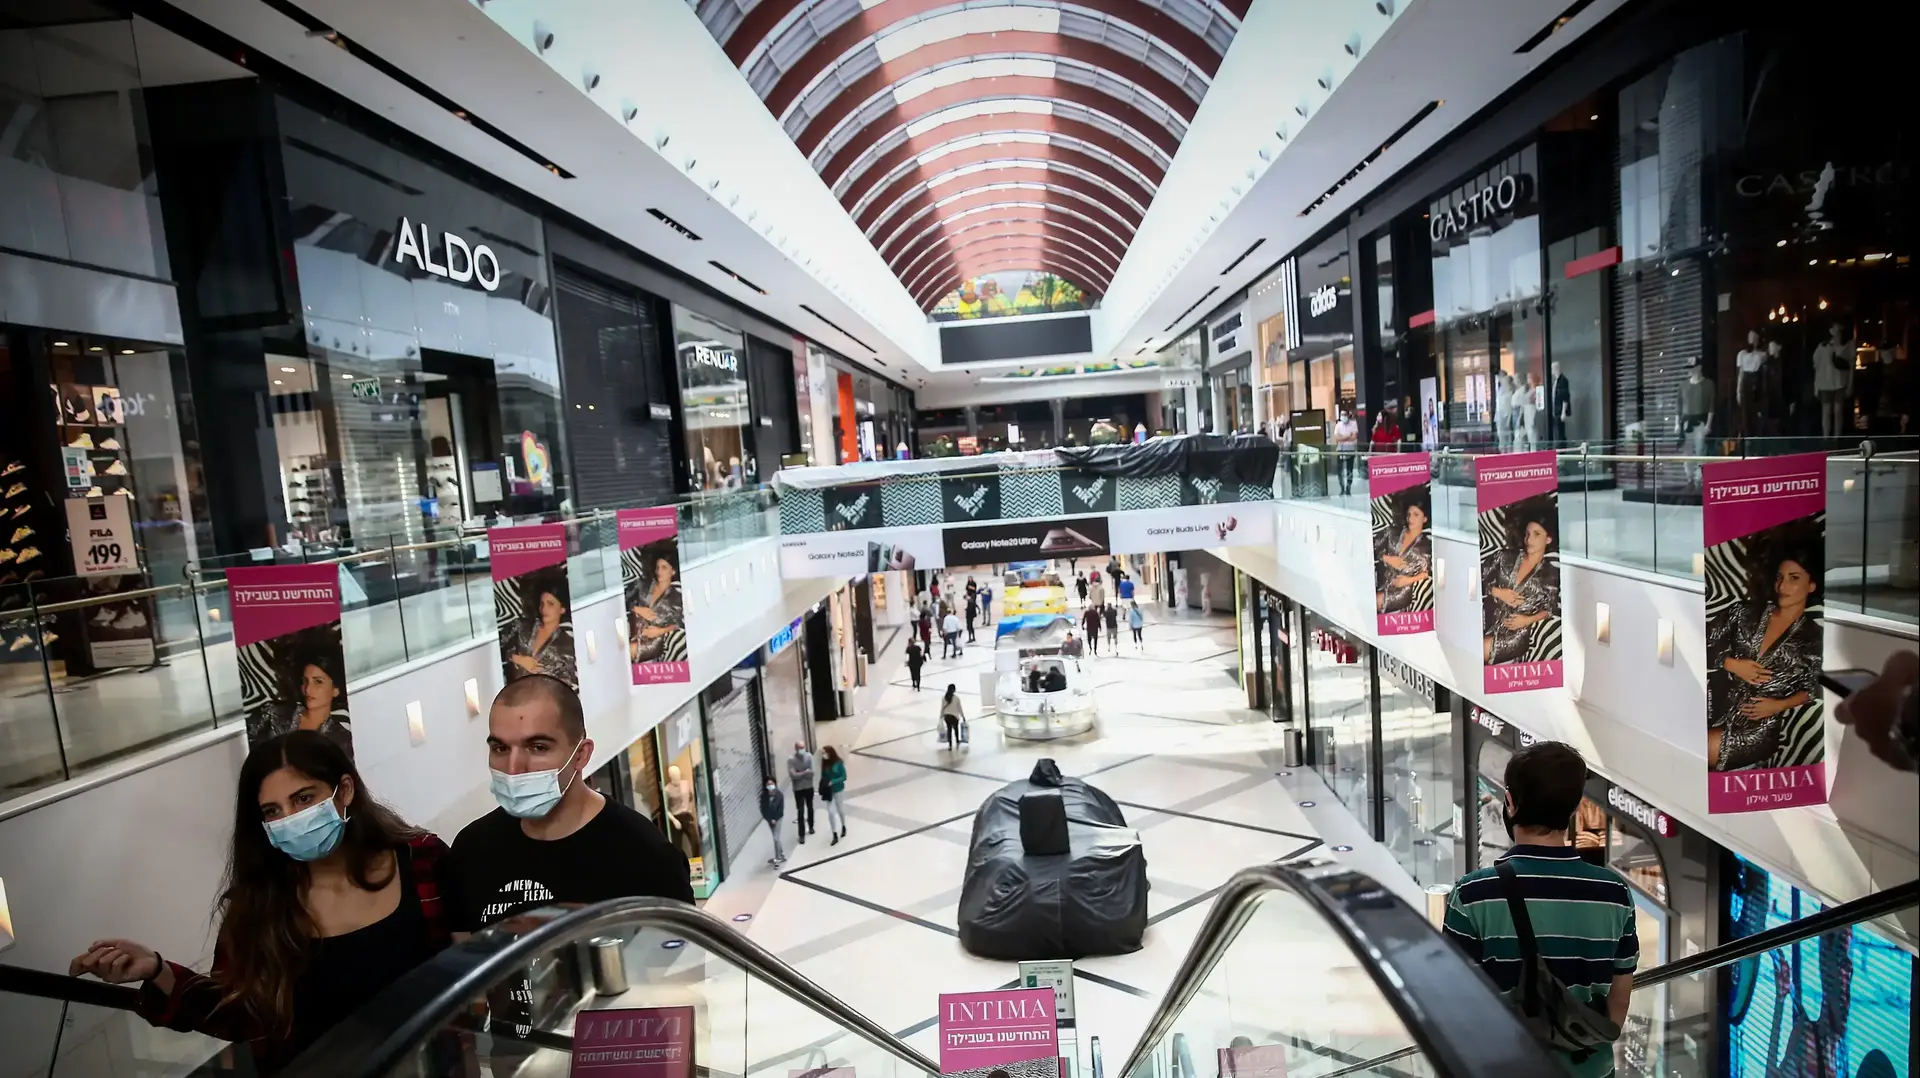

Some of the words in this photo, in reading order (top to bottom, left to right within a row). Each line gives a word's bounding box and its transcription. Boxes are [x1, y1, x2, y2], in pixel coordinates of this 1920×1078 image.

[1430, 175, 1516, 242] CASTRO
[396, 217, 500, 291] ALDO
[1311, 285, 1337, 318] adidas
[695, 345, 738, 372] RENUAR
[1480, 470, 1513, 482] בשבילך!
[1515, 467, 1553, 477] התחדשנו
[1763, 478, 1819, 492] התחדשנו
[1710, 484, 1760, 500] בשבילך!
[89, 528, 113, 537] FILA
[526, 540, 562, 551] התחדשנו
[961, 541, 990, 550] Galaxy
[990, 538, 1018, 547] Note20
[1018, 537, 1038, 545] Ultra
[88, 543, 121, 565] 199
[808, 552, 836, 560] Galaxy
[837, 549, 864, 557] Note20
[235, 590, 280, 603] בשבילך!
[282, 588, 333, 600] התחדשנו
[1384, 615, 1429, 626] INTIMA
[638, 664, 684, 676] INTIMA
[1377, 649, 1397, 677] ICE
[1399, 663, 1434, 701] CUBE
[1493, 663, 1554, 680] INTIMA
[1479, 712, 1505, 737] REEF
[1723, 770, 1815, 794] INTIMA
[1746, 793, 1770, 805] אילון
[1773, 791, 1793, 801] שער
[1608, 786, 1656, 830] element
[513, 879, 533, 891] NEW
[948, 998, 1049, 1022] INTIMA
[947, 1032, 994, 1047] בשבילך!
[997, 1029, 1050, 1042] התחדשנו
